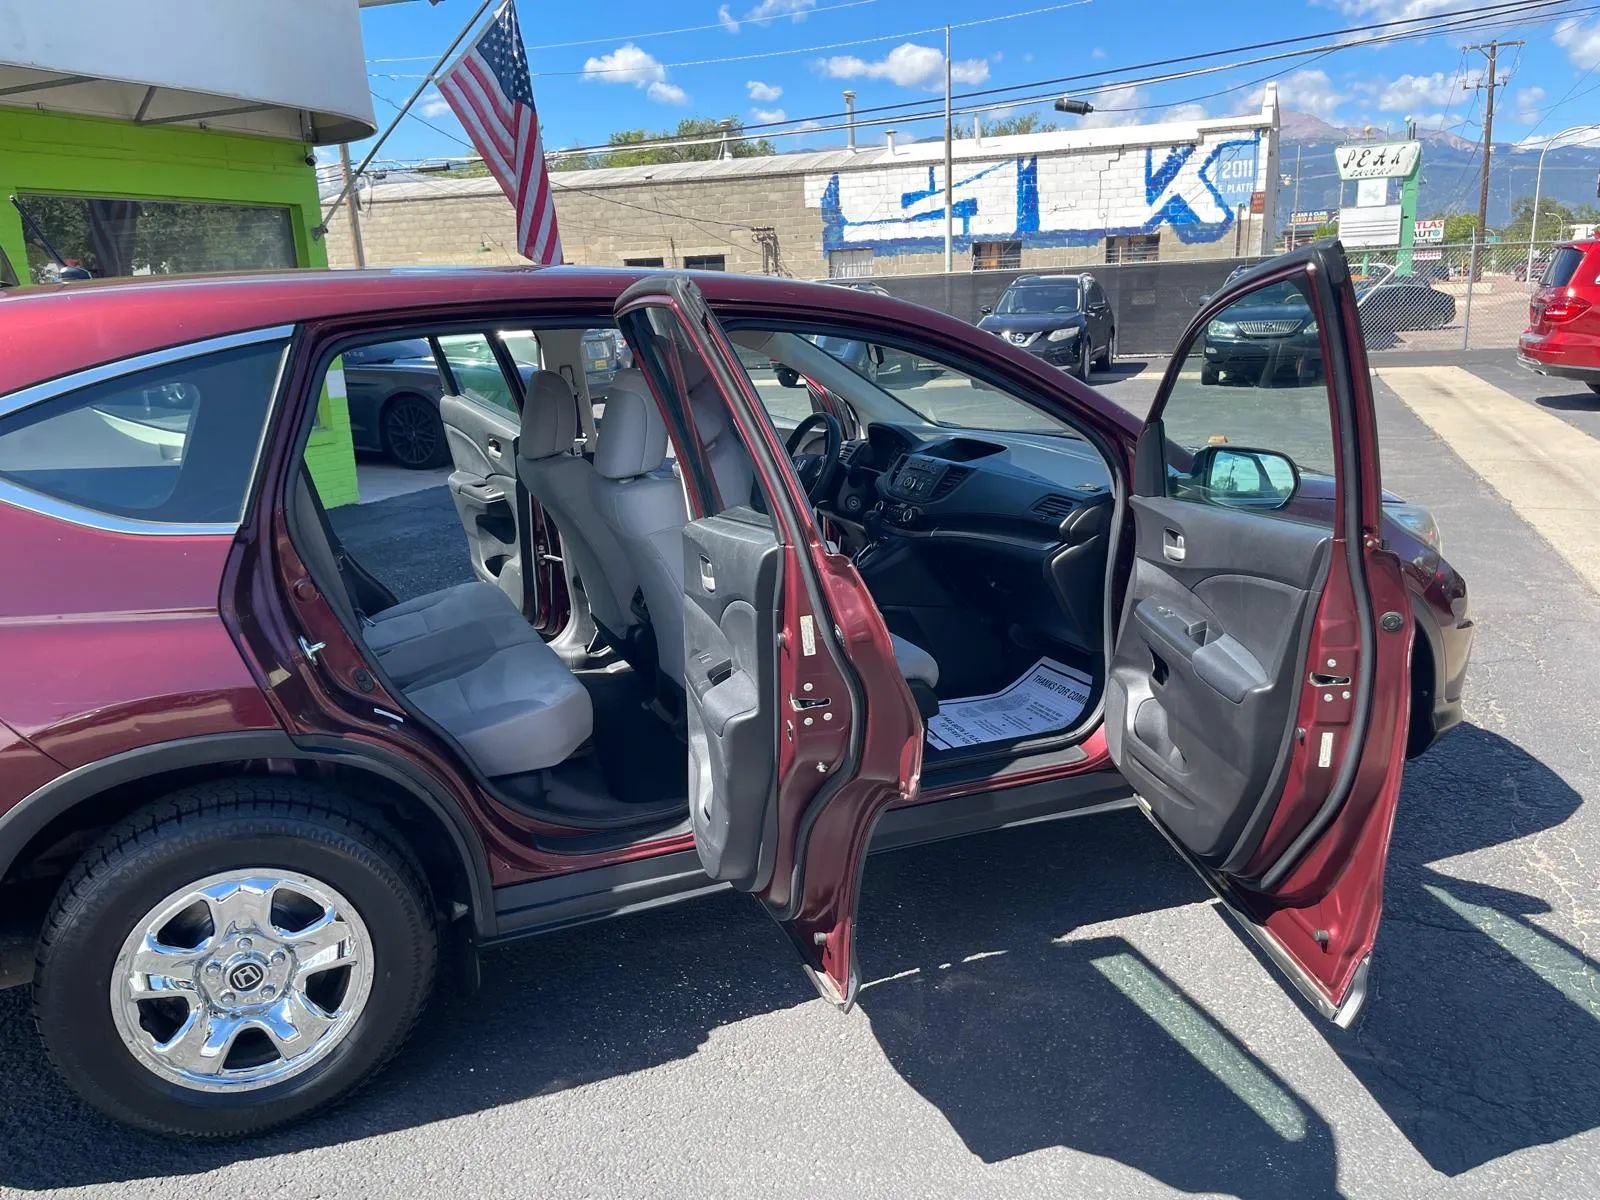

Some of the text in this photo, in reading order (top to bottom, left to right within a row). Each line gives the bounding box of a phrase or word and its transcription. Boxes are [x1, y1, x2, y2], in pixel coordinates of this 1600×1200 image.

[1222, 160, 1253, 178] 2011
[1227, 182, 1254, 193] PLATTE
[1415, 221, 1443, 229] TLAS
[1033, 675, 1058, 690] THANKS
[1054, 684, 1071, 696] FOR
